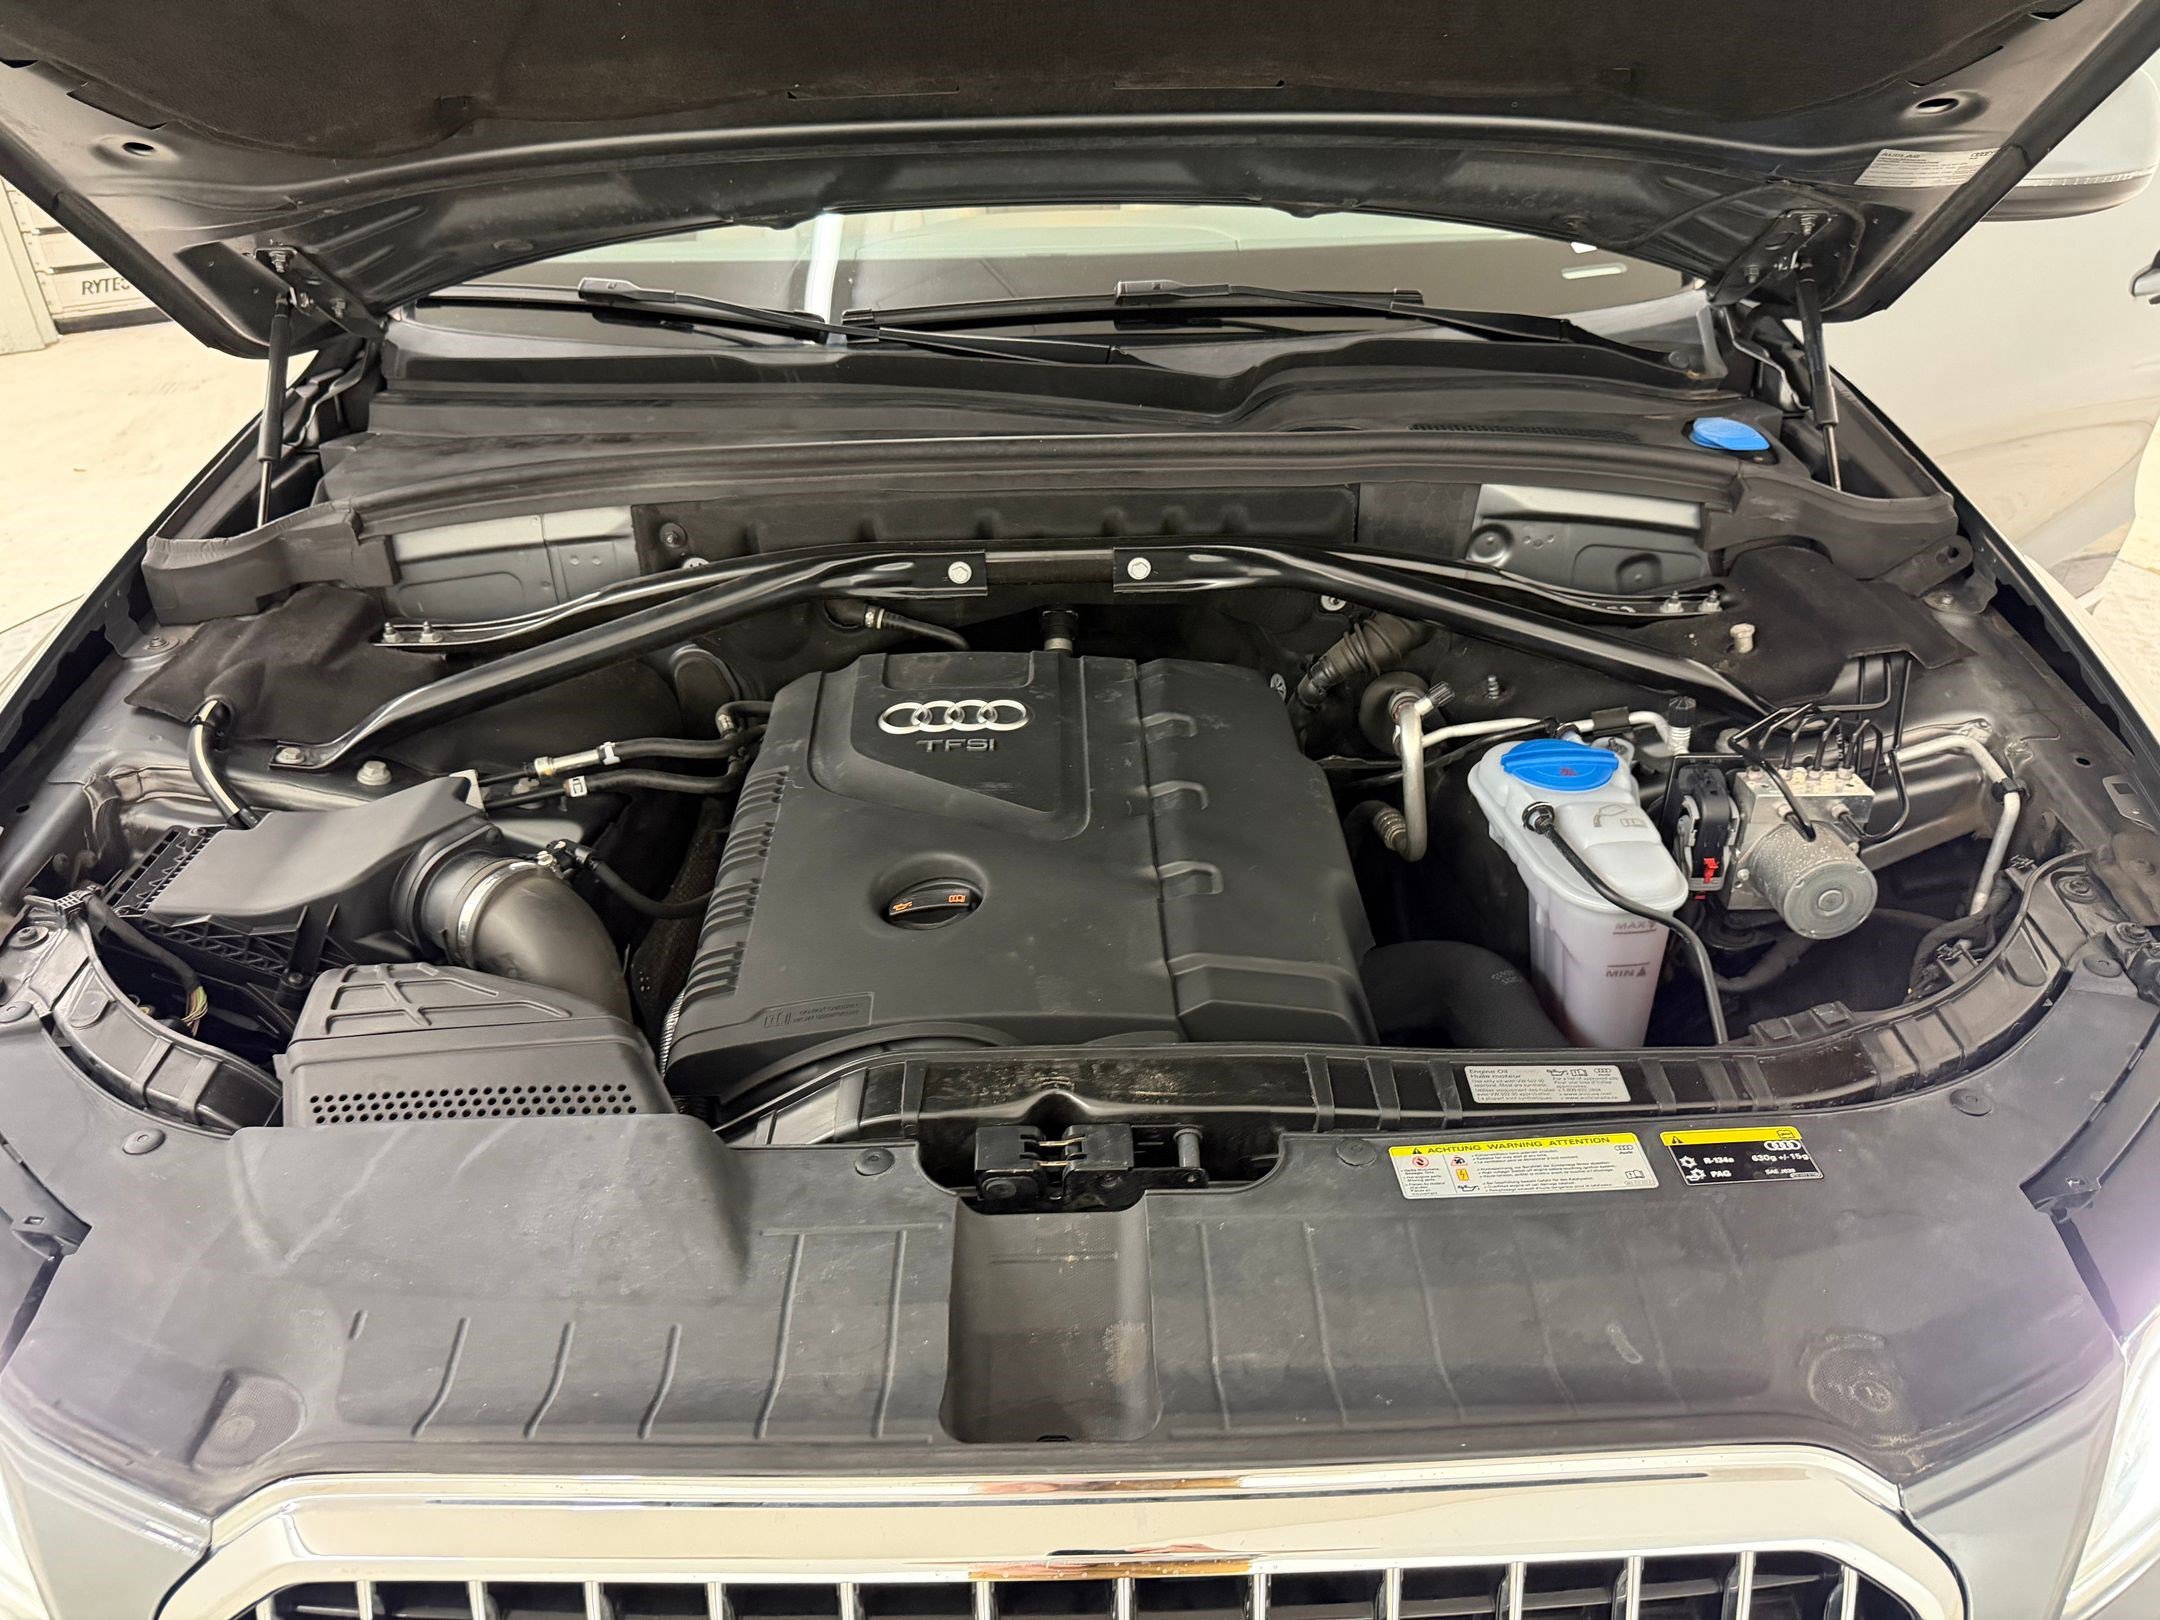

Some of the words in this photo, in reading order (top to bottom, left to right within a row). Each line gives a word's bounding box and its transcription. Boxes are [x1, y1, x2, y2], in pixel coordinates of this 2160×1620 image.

[916, 738, 995, 752] TFSI
[1615, 921, 1646, 929] MAX
[1606, 969, 1634, 977] MIN
[1428, 1144, 1481, 1153] ACHTUNG
[1487, 1141, 1542, 1150] WARNING
[1549, 1137, 1610, 1146] ATTENTION
[1703, 1156, 1735, 1164] R-134a
[1751, 1154, 1777, 1162] 630g
